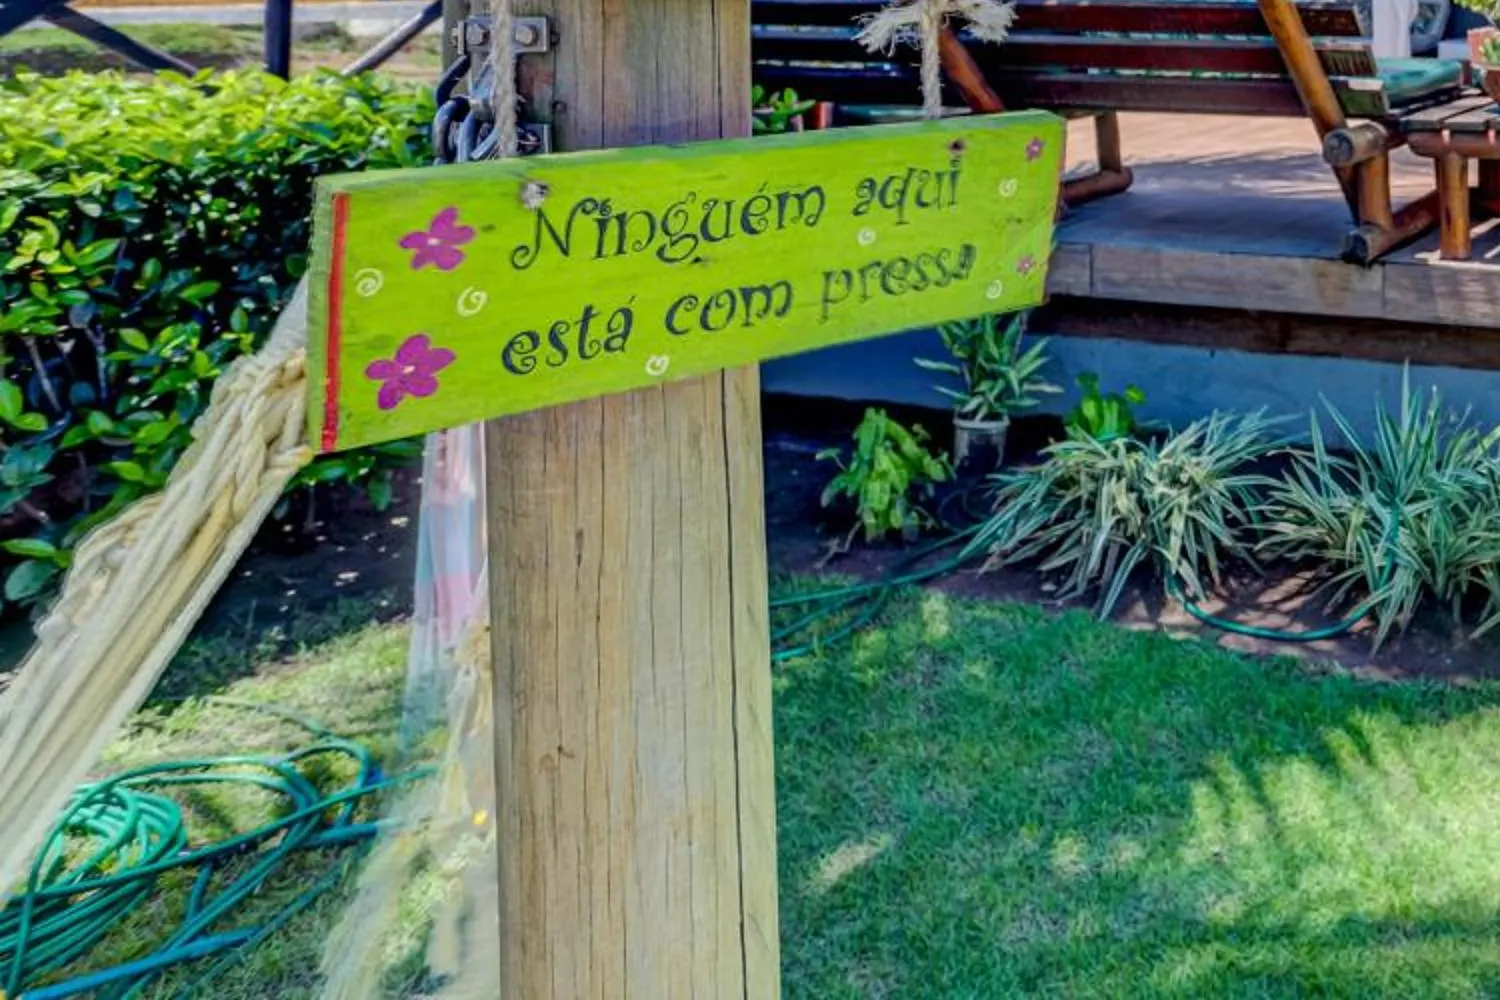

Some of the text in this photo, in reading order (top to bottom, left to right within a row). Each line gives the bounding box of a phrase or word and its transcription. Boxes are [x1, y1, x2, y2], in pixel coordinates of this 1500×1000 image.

[511, 154, 962, 270] Ninguém aqui
[501, 243, 977, 375] está com pressa
